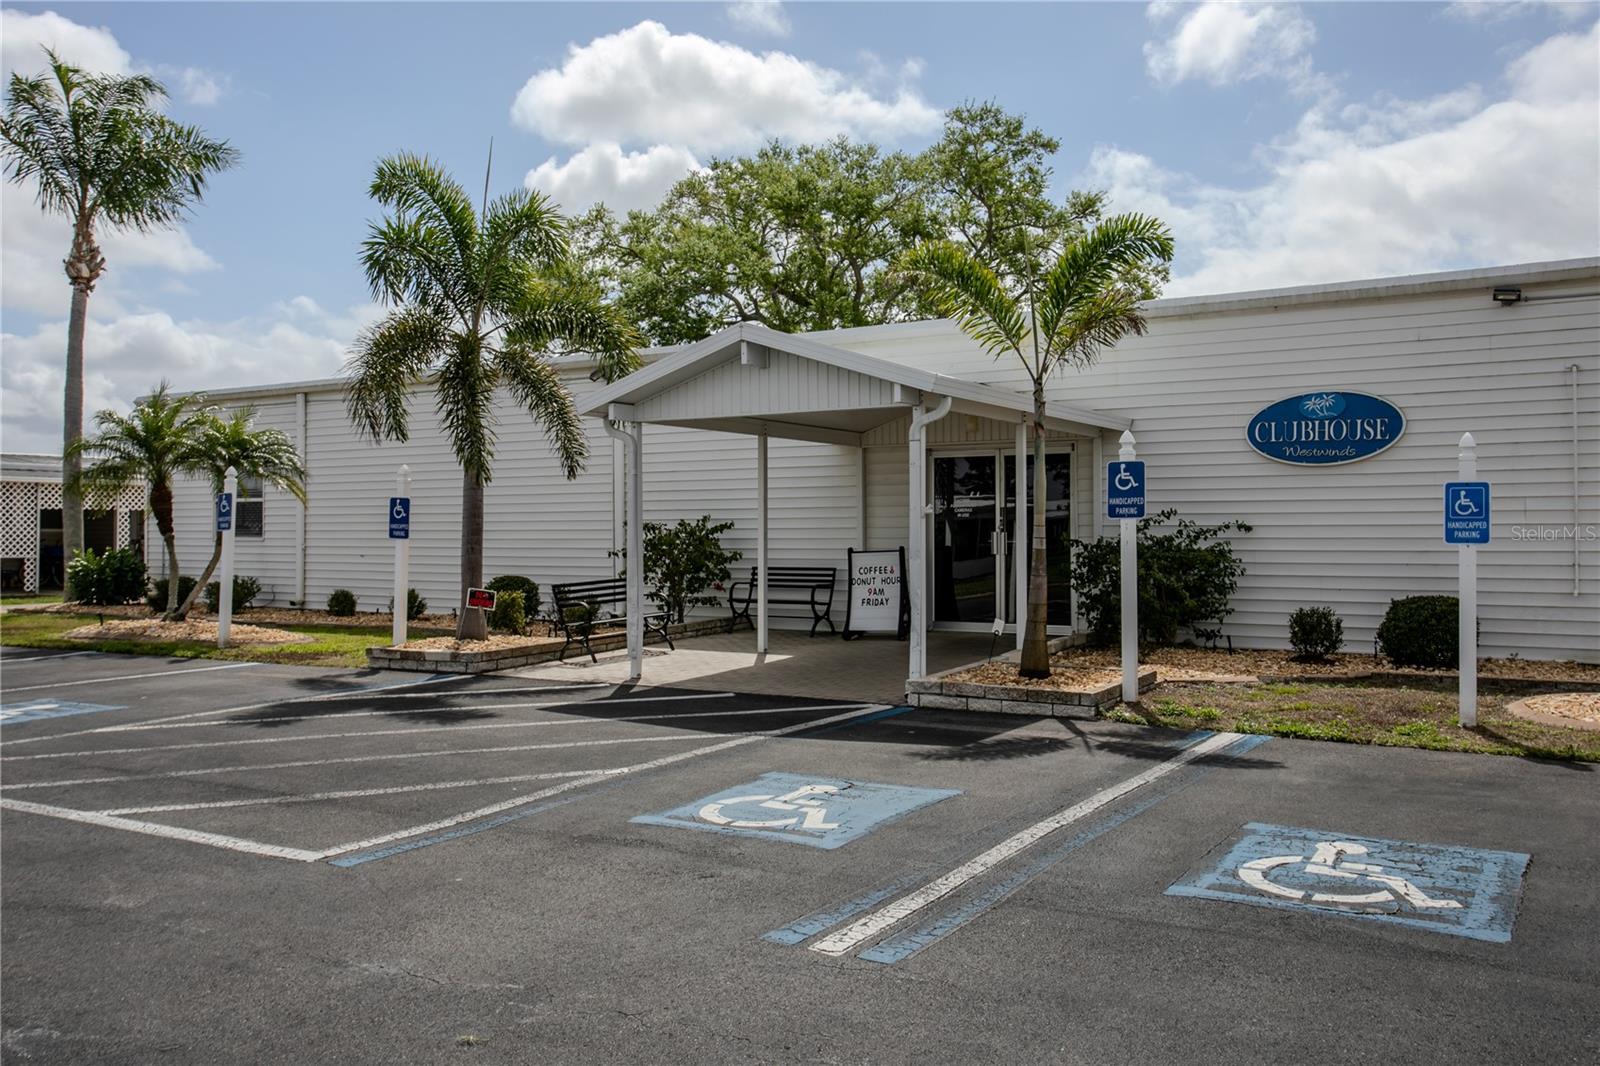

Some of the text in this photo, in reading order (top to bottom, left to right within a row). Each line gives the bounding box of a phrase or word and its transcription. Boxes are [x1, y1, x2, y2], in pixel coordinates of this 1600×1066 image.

[1254, 418, 1390, 443] CLUBHOUSE
[1282, 445, 1357, 457] Westwinds
[1109, 497, 1144, 505] HANDICAPPED
[1115, 507, 1138, 515] PARKING
[1447, 521, 1488, 529] HANDICAPPED
[1454, 530, 1480, 539] PARKING
[851, 577, 876, 586] DONUT
[867, 587, 885, 597] 9AM
[861, 598, 890, 607] FRIDAY
